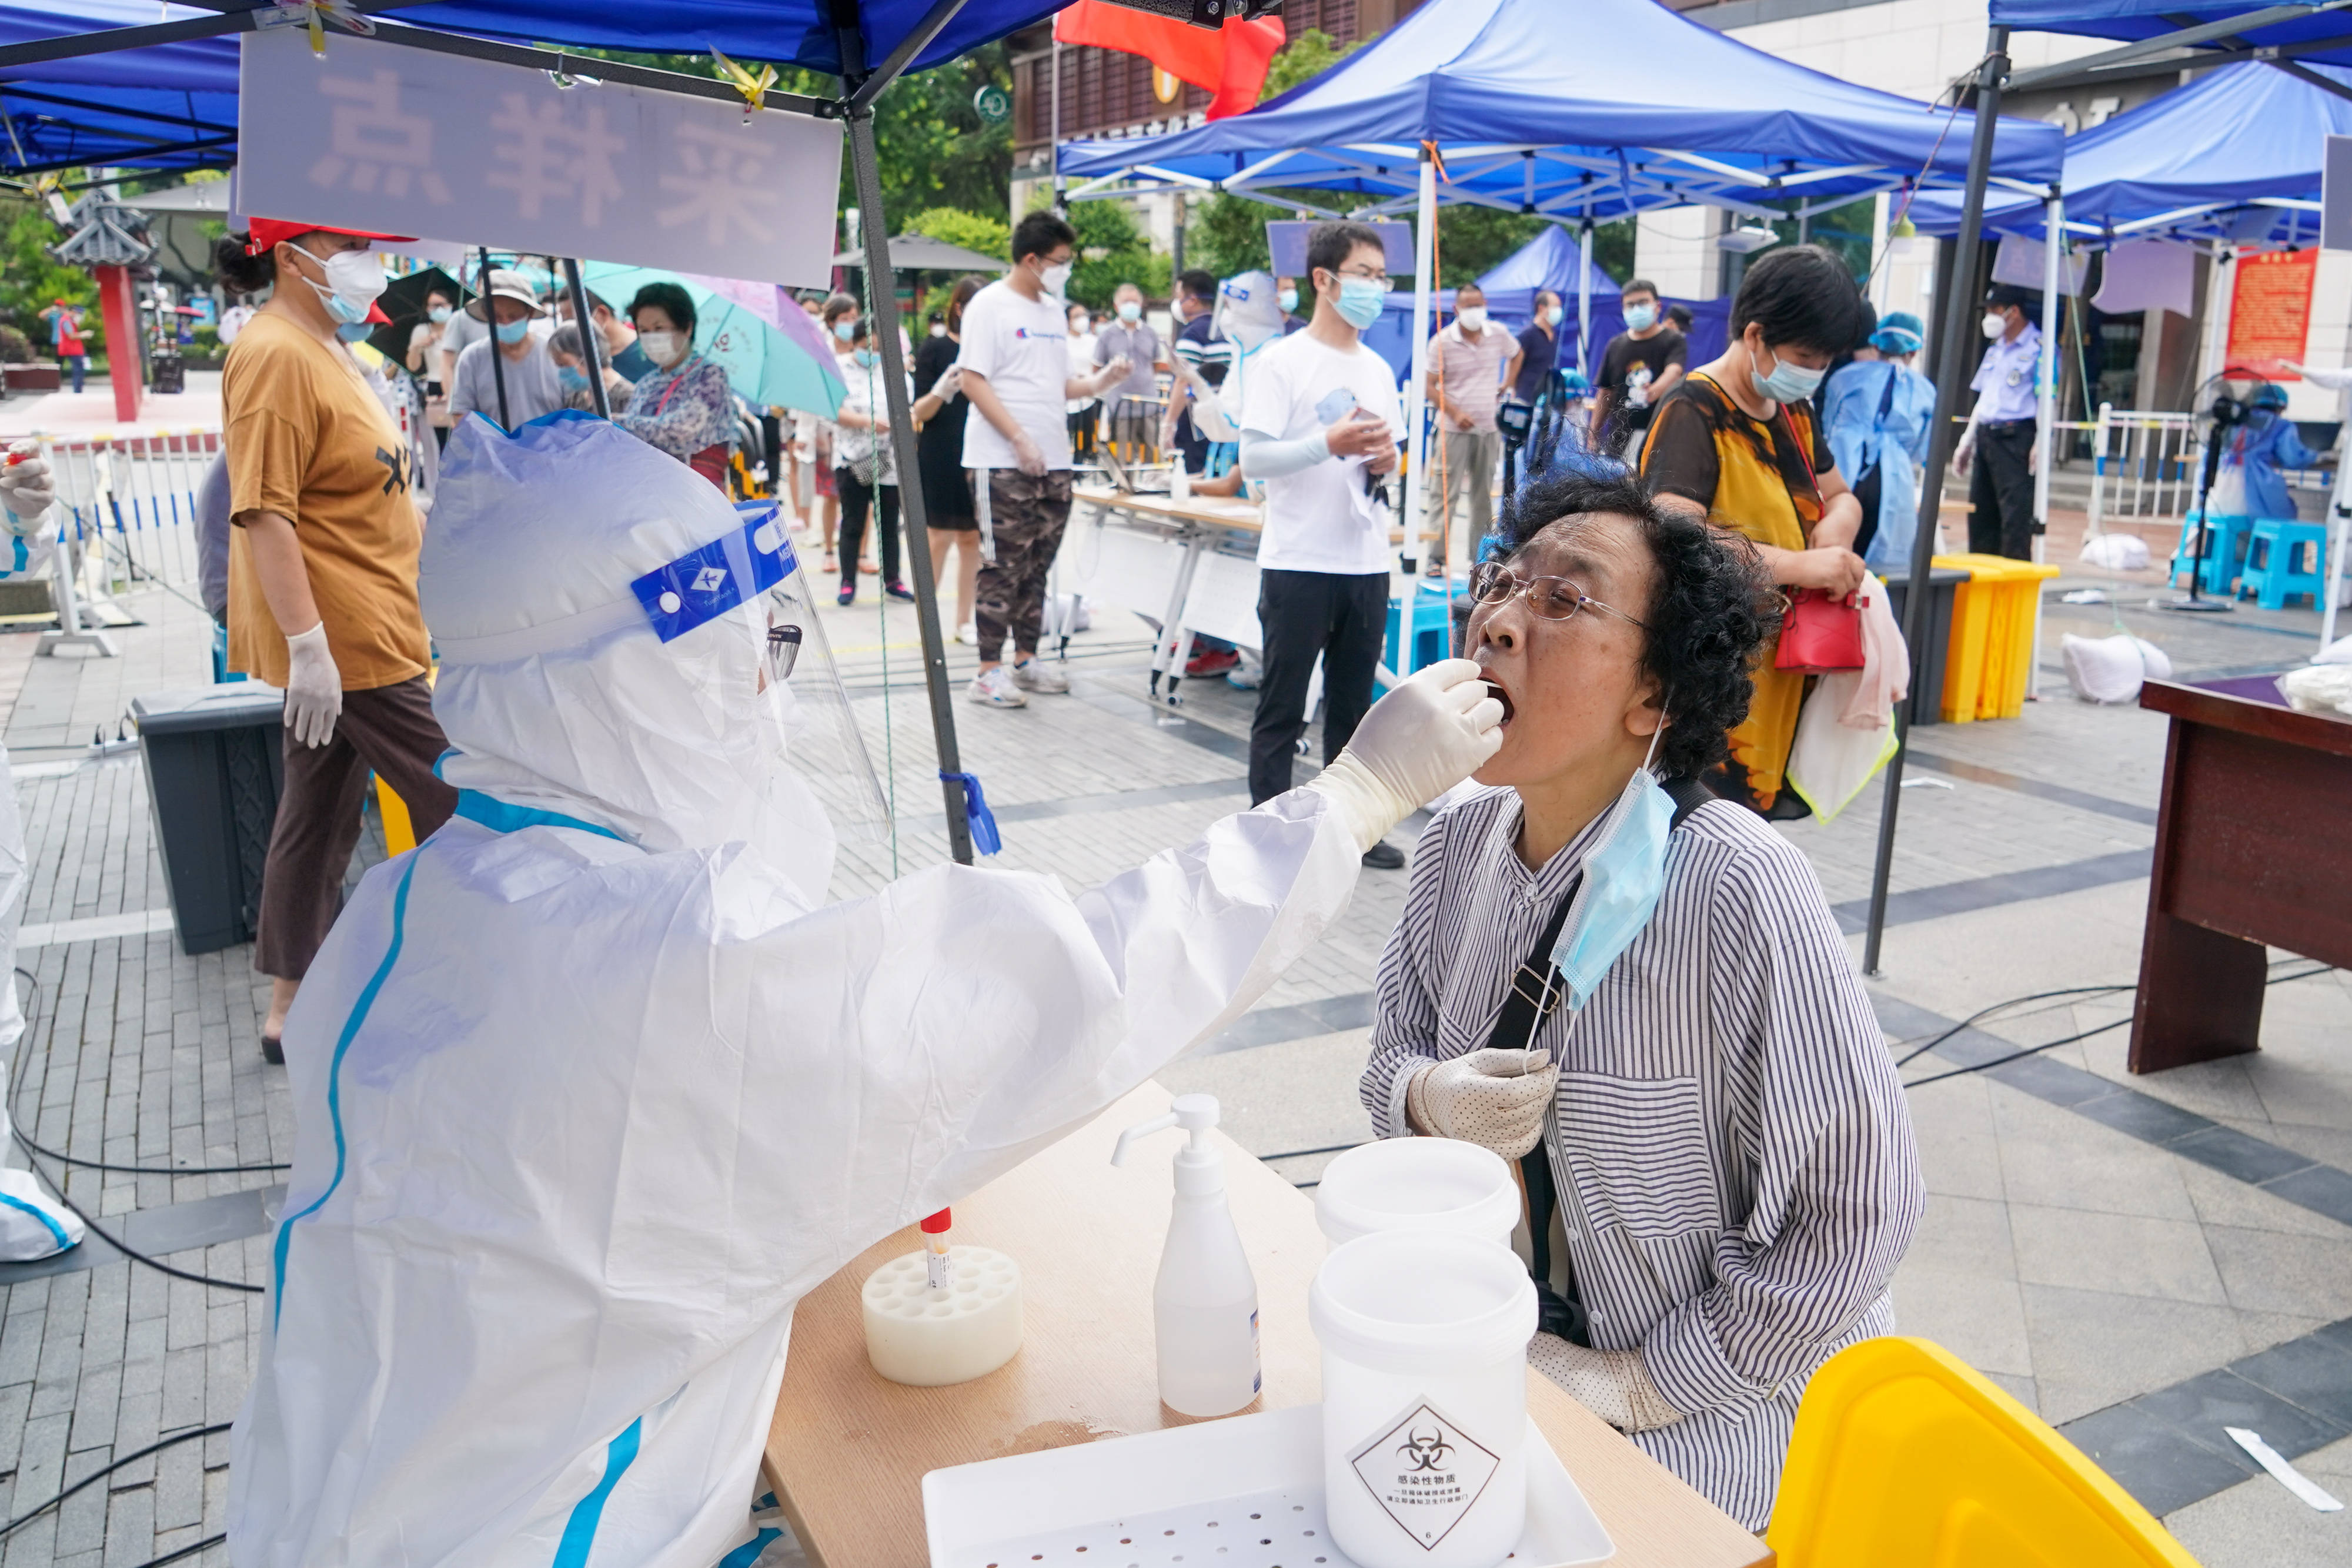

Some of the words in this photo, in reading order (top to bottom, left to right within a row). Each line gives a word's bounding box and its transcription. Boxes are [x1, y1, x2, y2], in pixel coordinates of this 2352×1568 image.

[1398, 1473, 1456, 1485] 感染性物质
